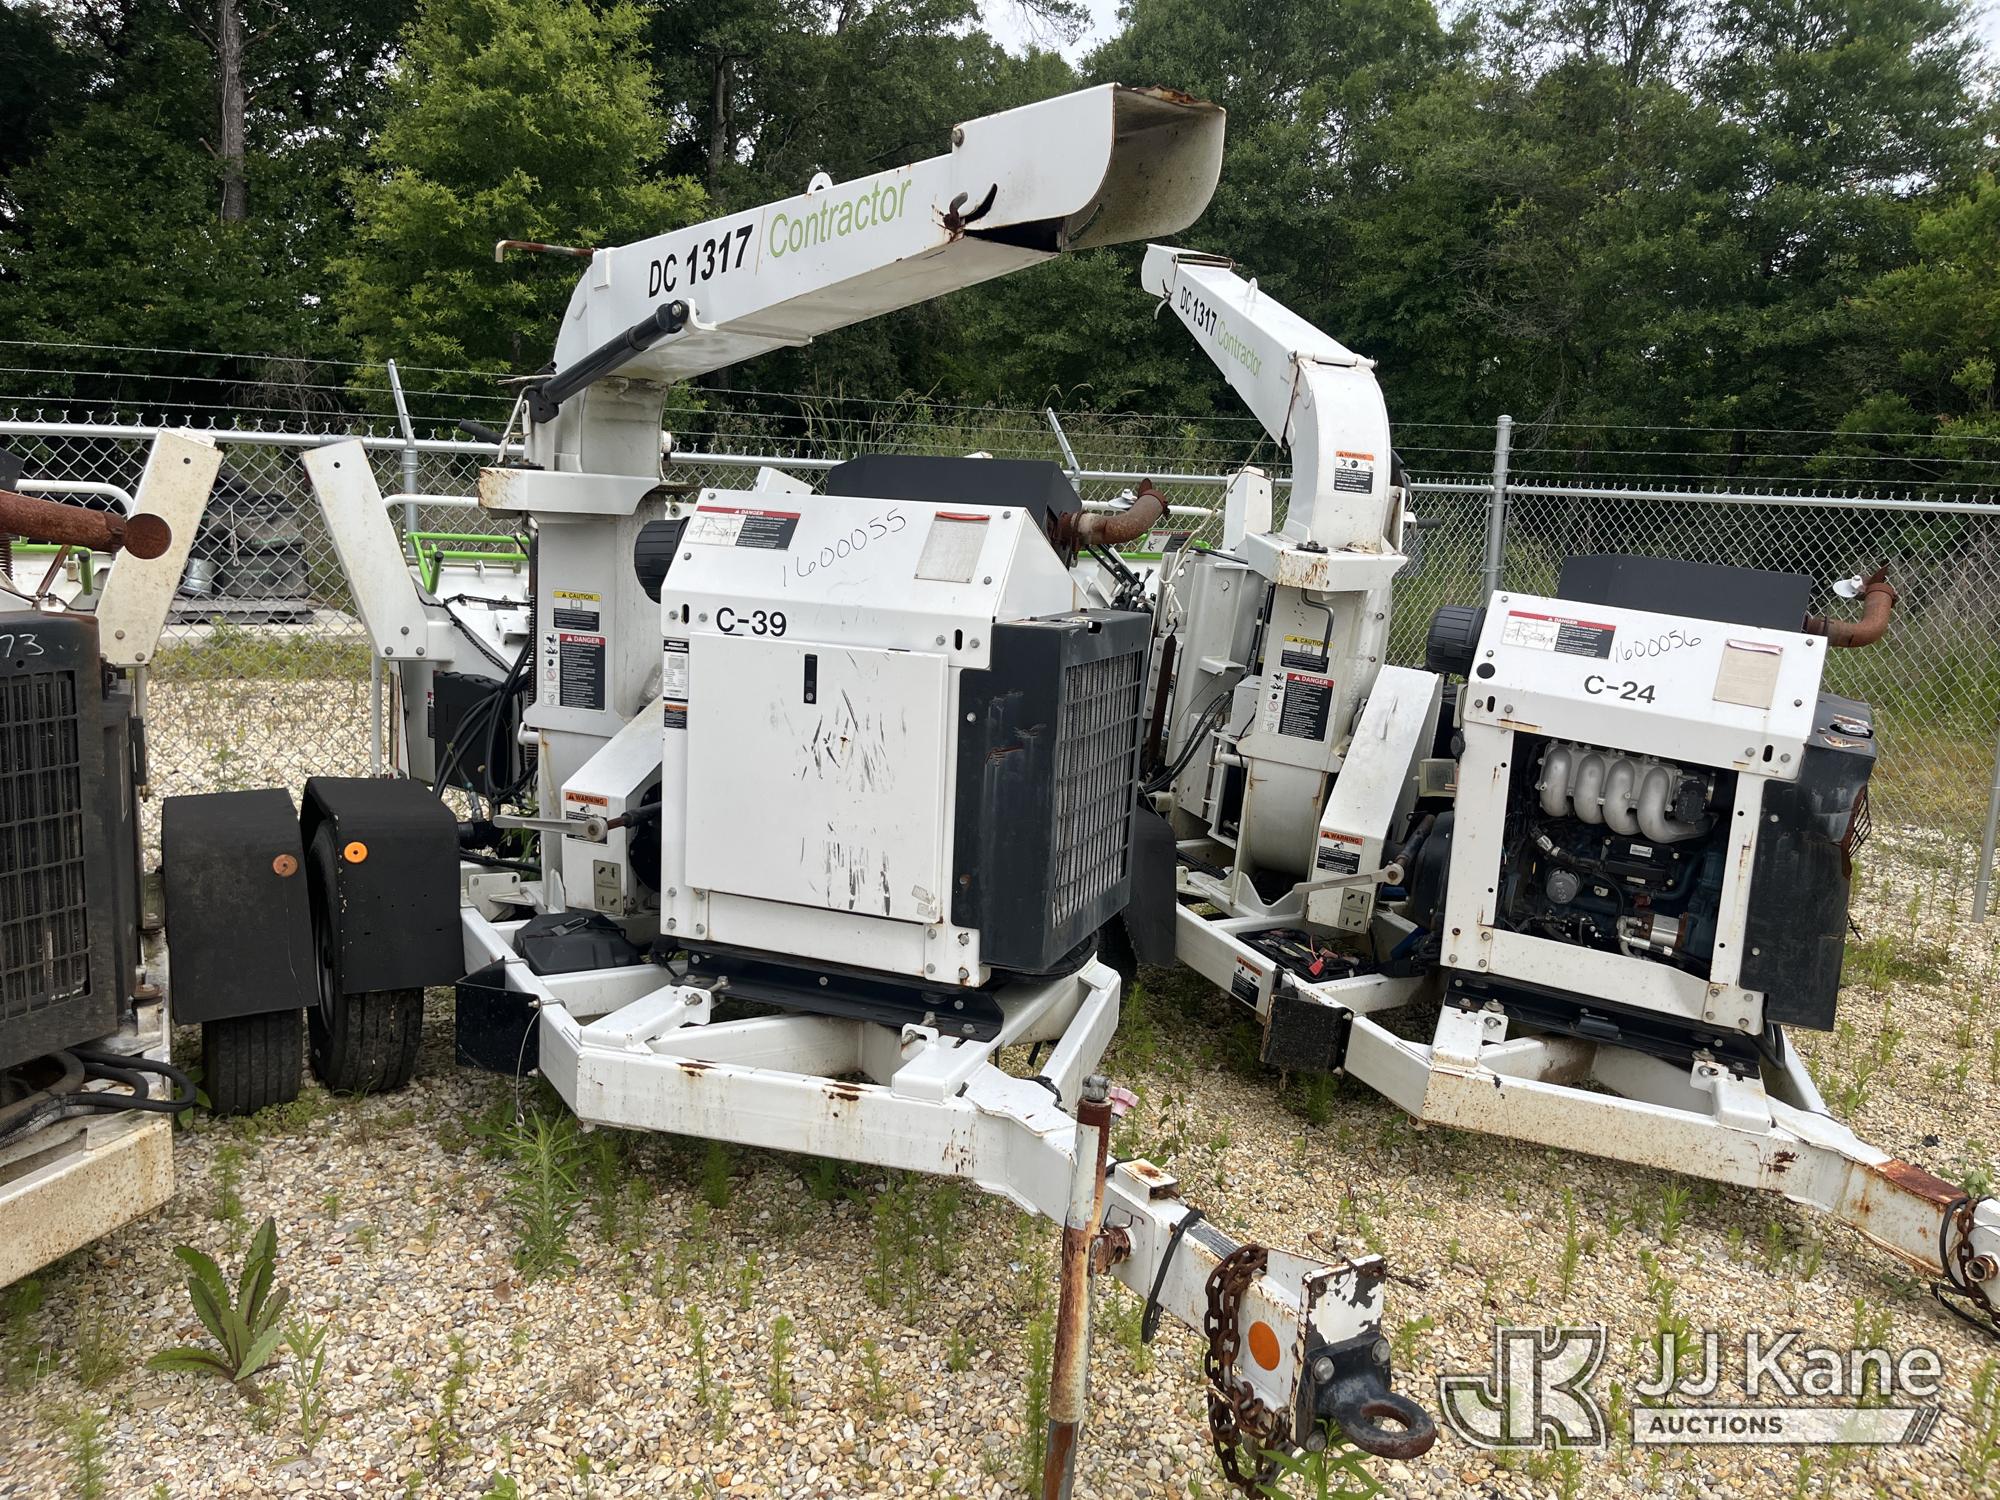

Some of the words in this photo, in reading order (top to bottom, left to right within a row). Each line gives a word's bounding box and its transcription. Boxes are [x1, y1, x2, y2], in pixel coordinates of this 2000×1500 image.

[648, 253, 678, 298] DC
[685, 223, 754, 285] 1317
[769, 177, 912, 258] Contractor
[1179, 286, 1193, 319] DC
[1193, 298, 1218, 337] 1317
[1217, 320, 1262, 380] Contractor
[782, 508, 907, 587] 1600055
[568, 592, 594, 601] CAUTION
[716, 606, 787, 637] C-39
[1554, 617, 1578, 625] DANGER
[573, 635, 600, 644] DANGER
[1615, 629, 1702, 664] 1600056
[1301, 675, 1328, 686] DANGER
[1584, 674, 1656, 704] C-24
[575, 794, 604, 805] WARNING
[1330, 832, 1359, 845] WARNING
